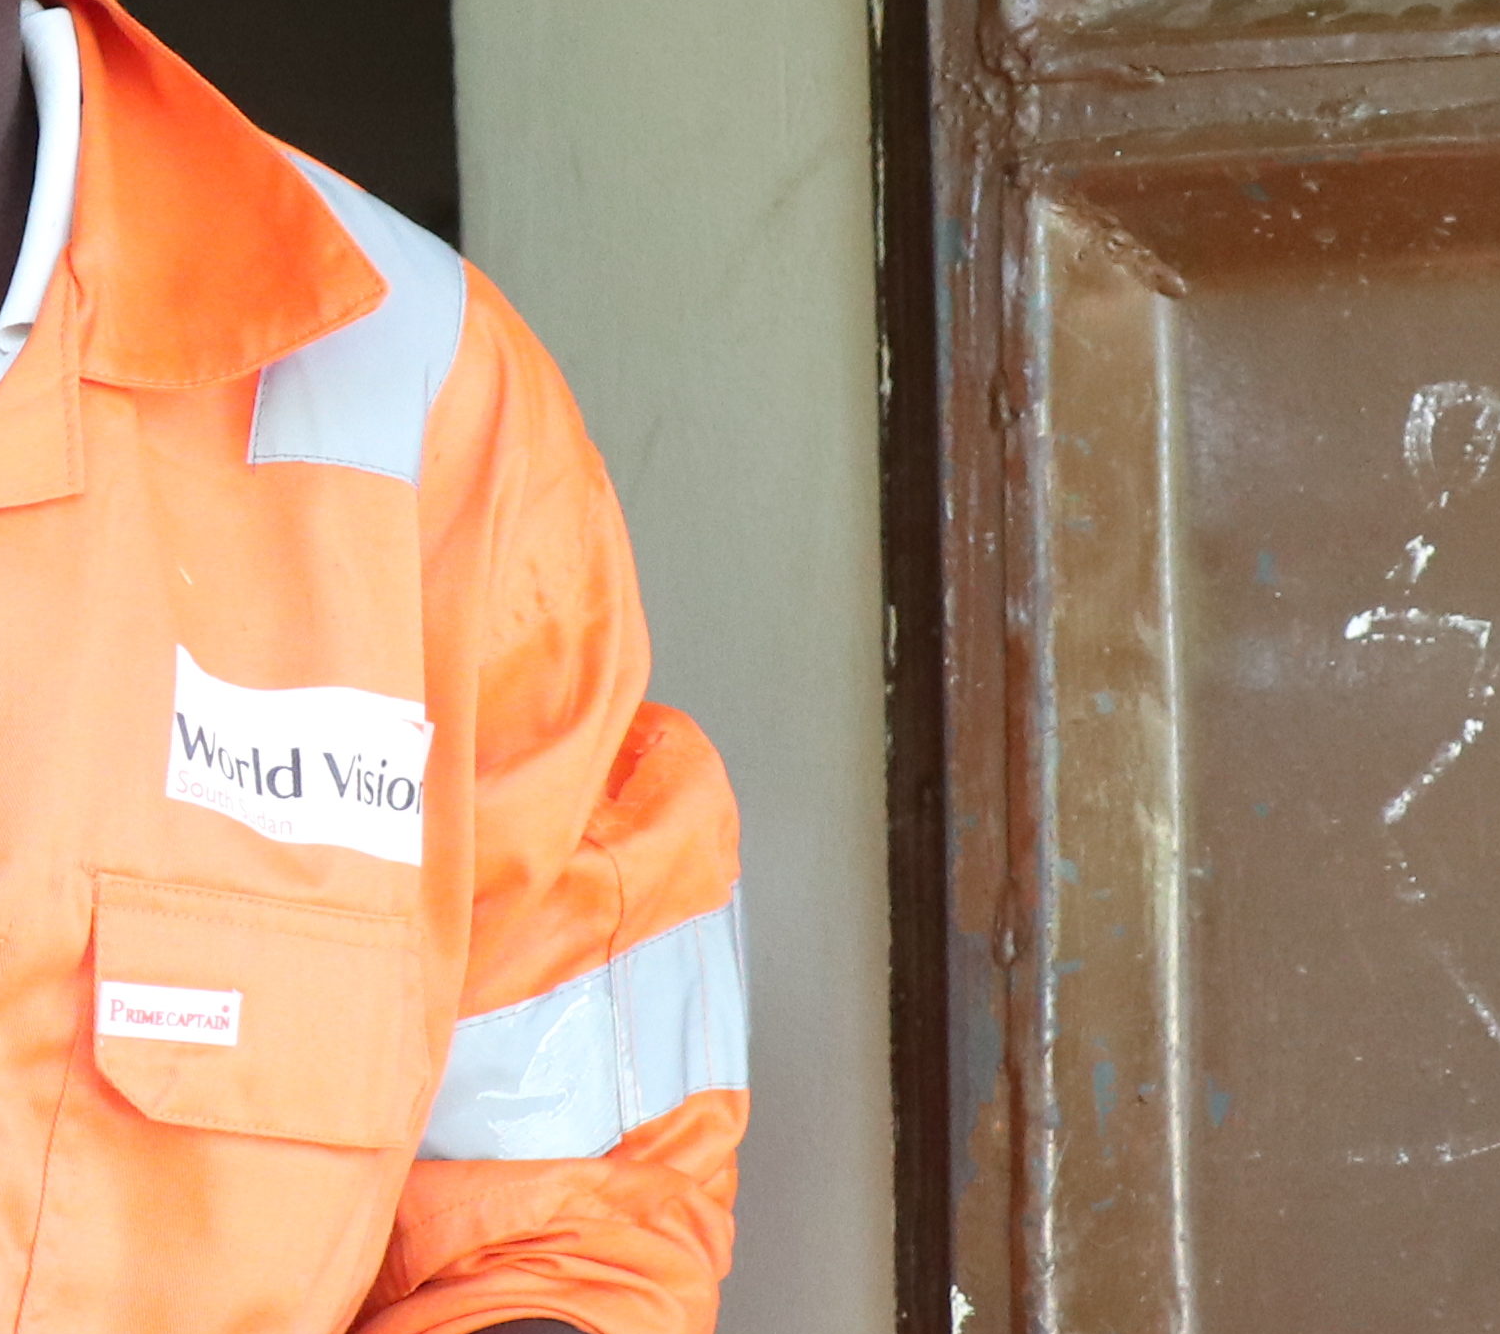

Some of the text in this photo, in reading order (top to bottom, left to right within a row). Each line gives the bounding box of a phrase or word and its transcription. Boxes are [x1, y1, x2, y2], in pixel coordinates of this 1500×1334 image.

[174, 711, 303, 800] World
[175, 769, 294, 836] South Sudan
